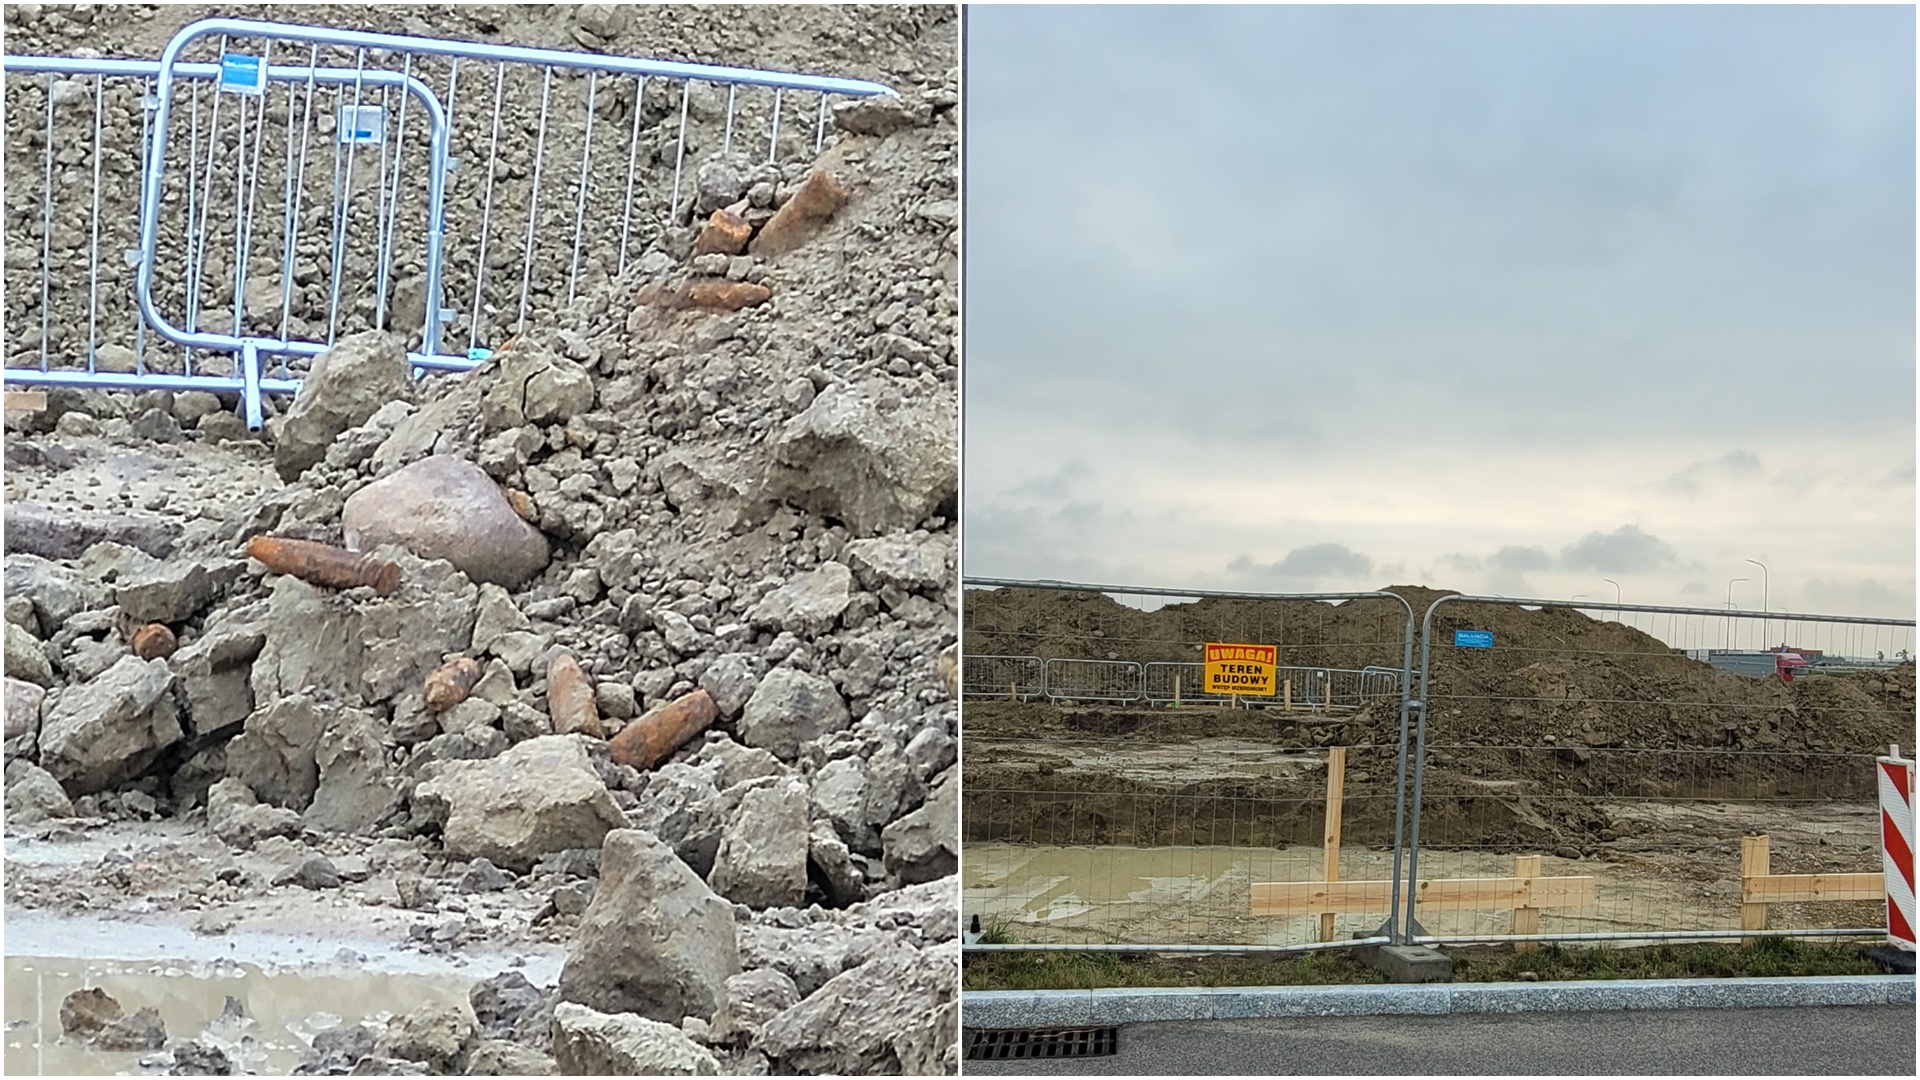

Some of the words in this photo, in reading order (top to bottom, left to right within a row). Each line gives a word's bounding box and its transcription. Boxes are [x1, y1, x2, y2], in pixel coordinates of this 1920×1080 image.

[1209, 648, 1273, 663] UWAGA!
[1220, 664, 1262, 674] TEREN
[1213, 674, 1269, 685] BUDOWY
